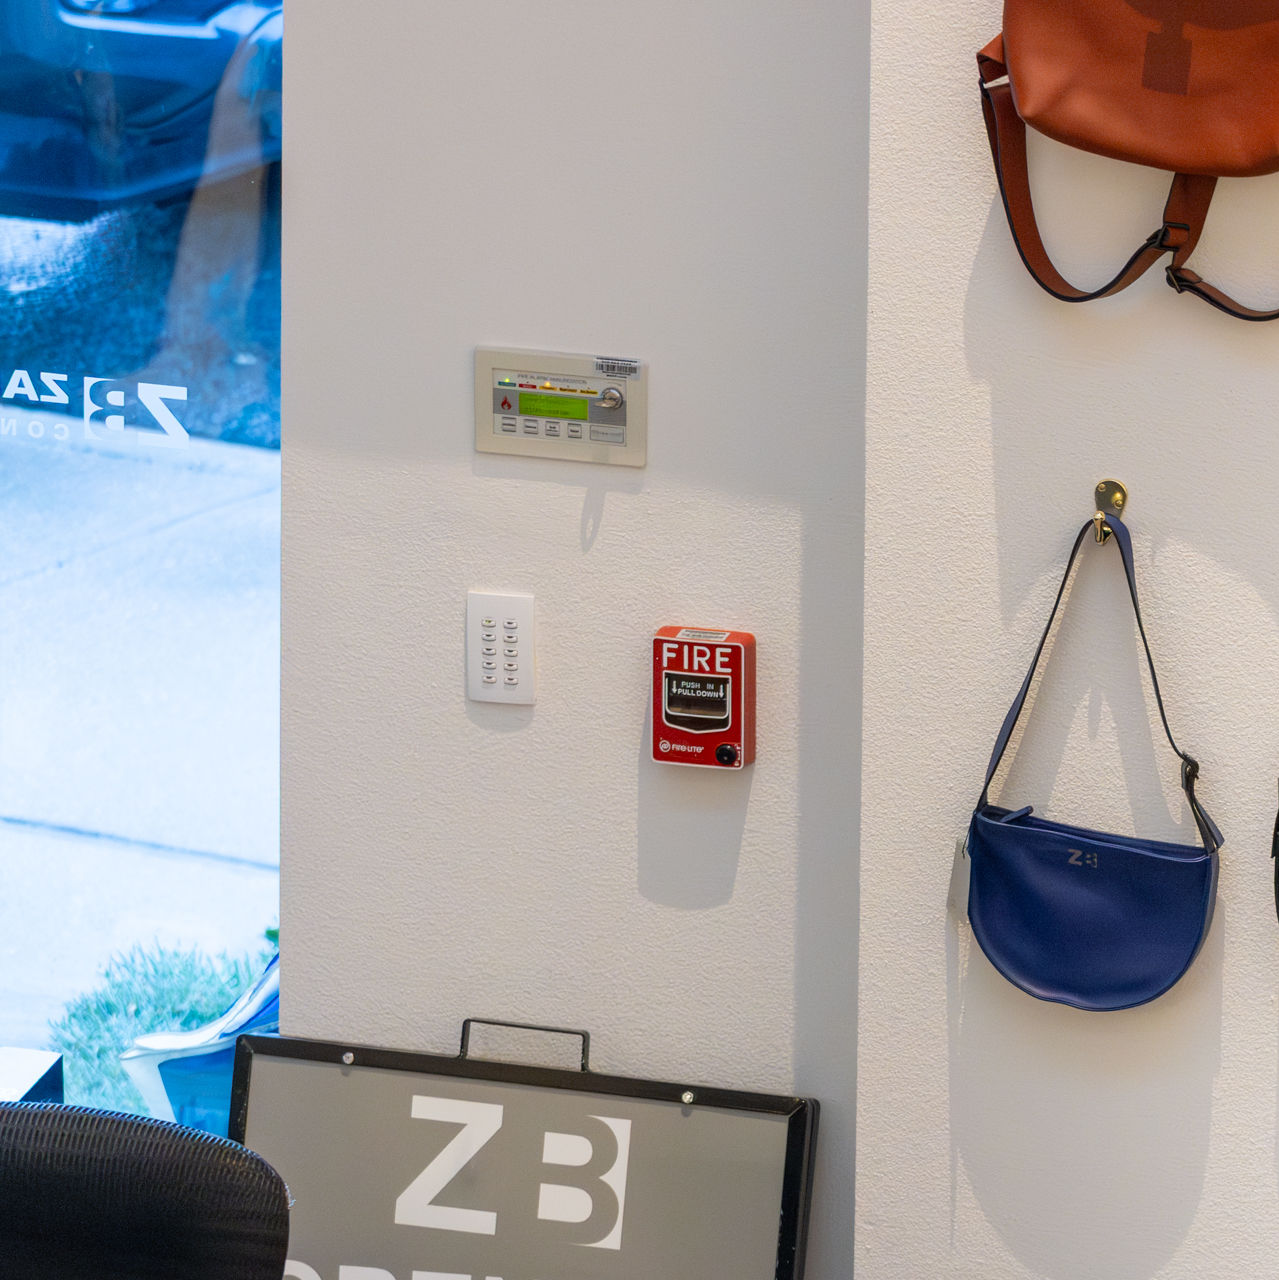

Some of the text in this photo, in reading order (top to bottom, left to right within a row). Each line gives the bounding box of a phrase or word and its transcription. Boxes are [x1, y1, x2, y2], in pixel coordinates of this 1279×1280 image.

[662, 642, 732, 673] FIRE
[681, 680, 701, 689] PUSH
[677, 688, 719, 698] PULL DOWN
